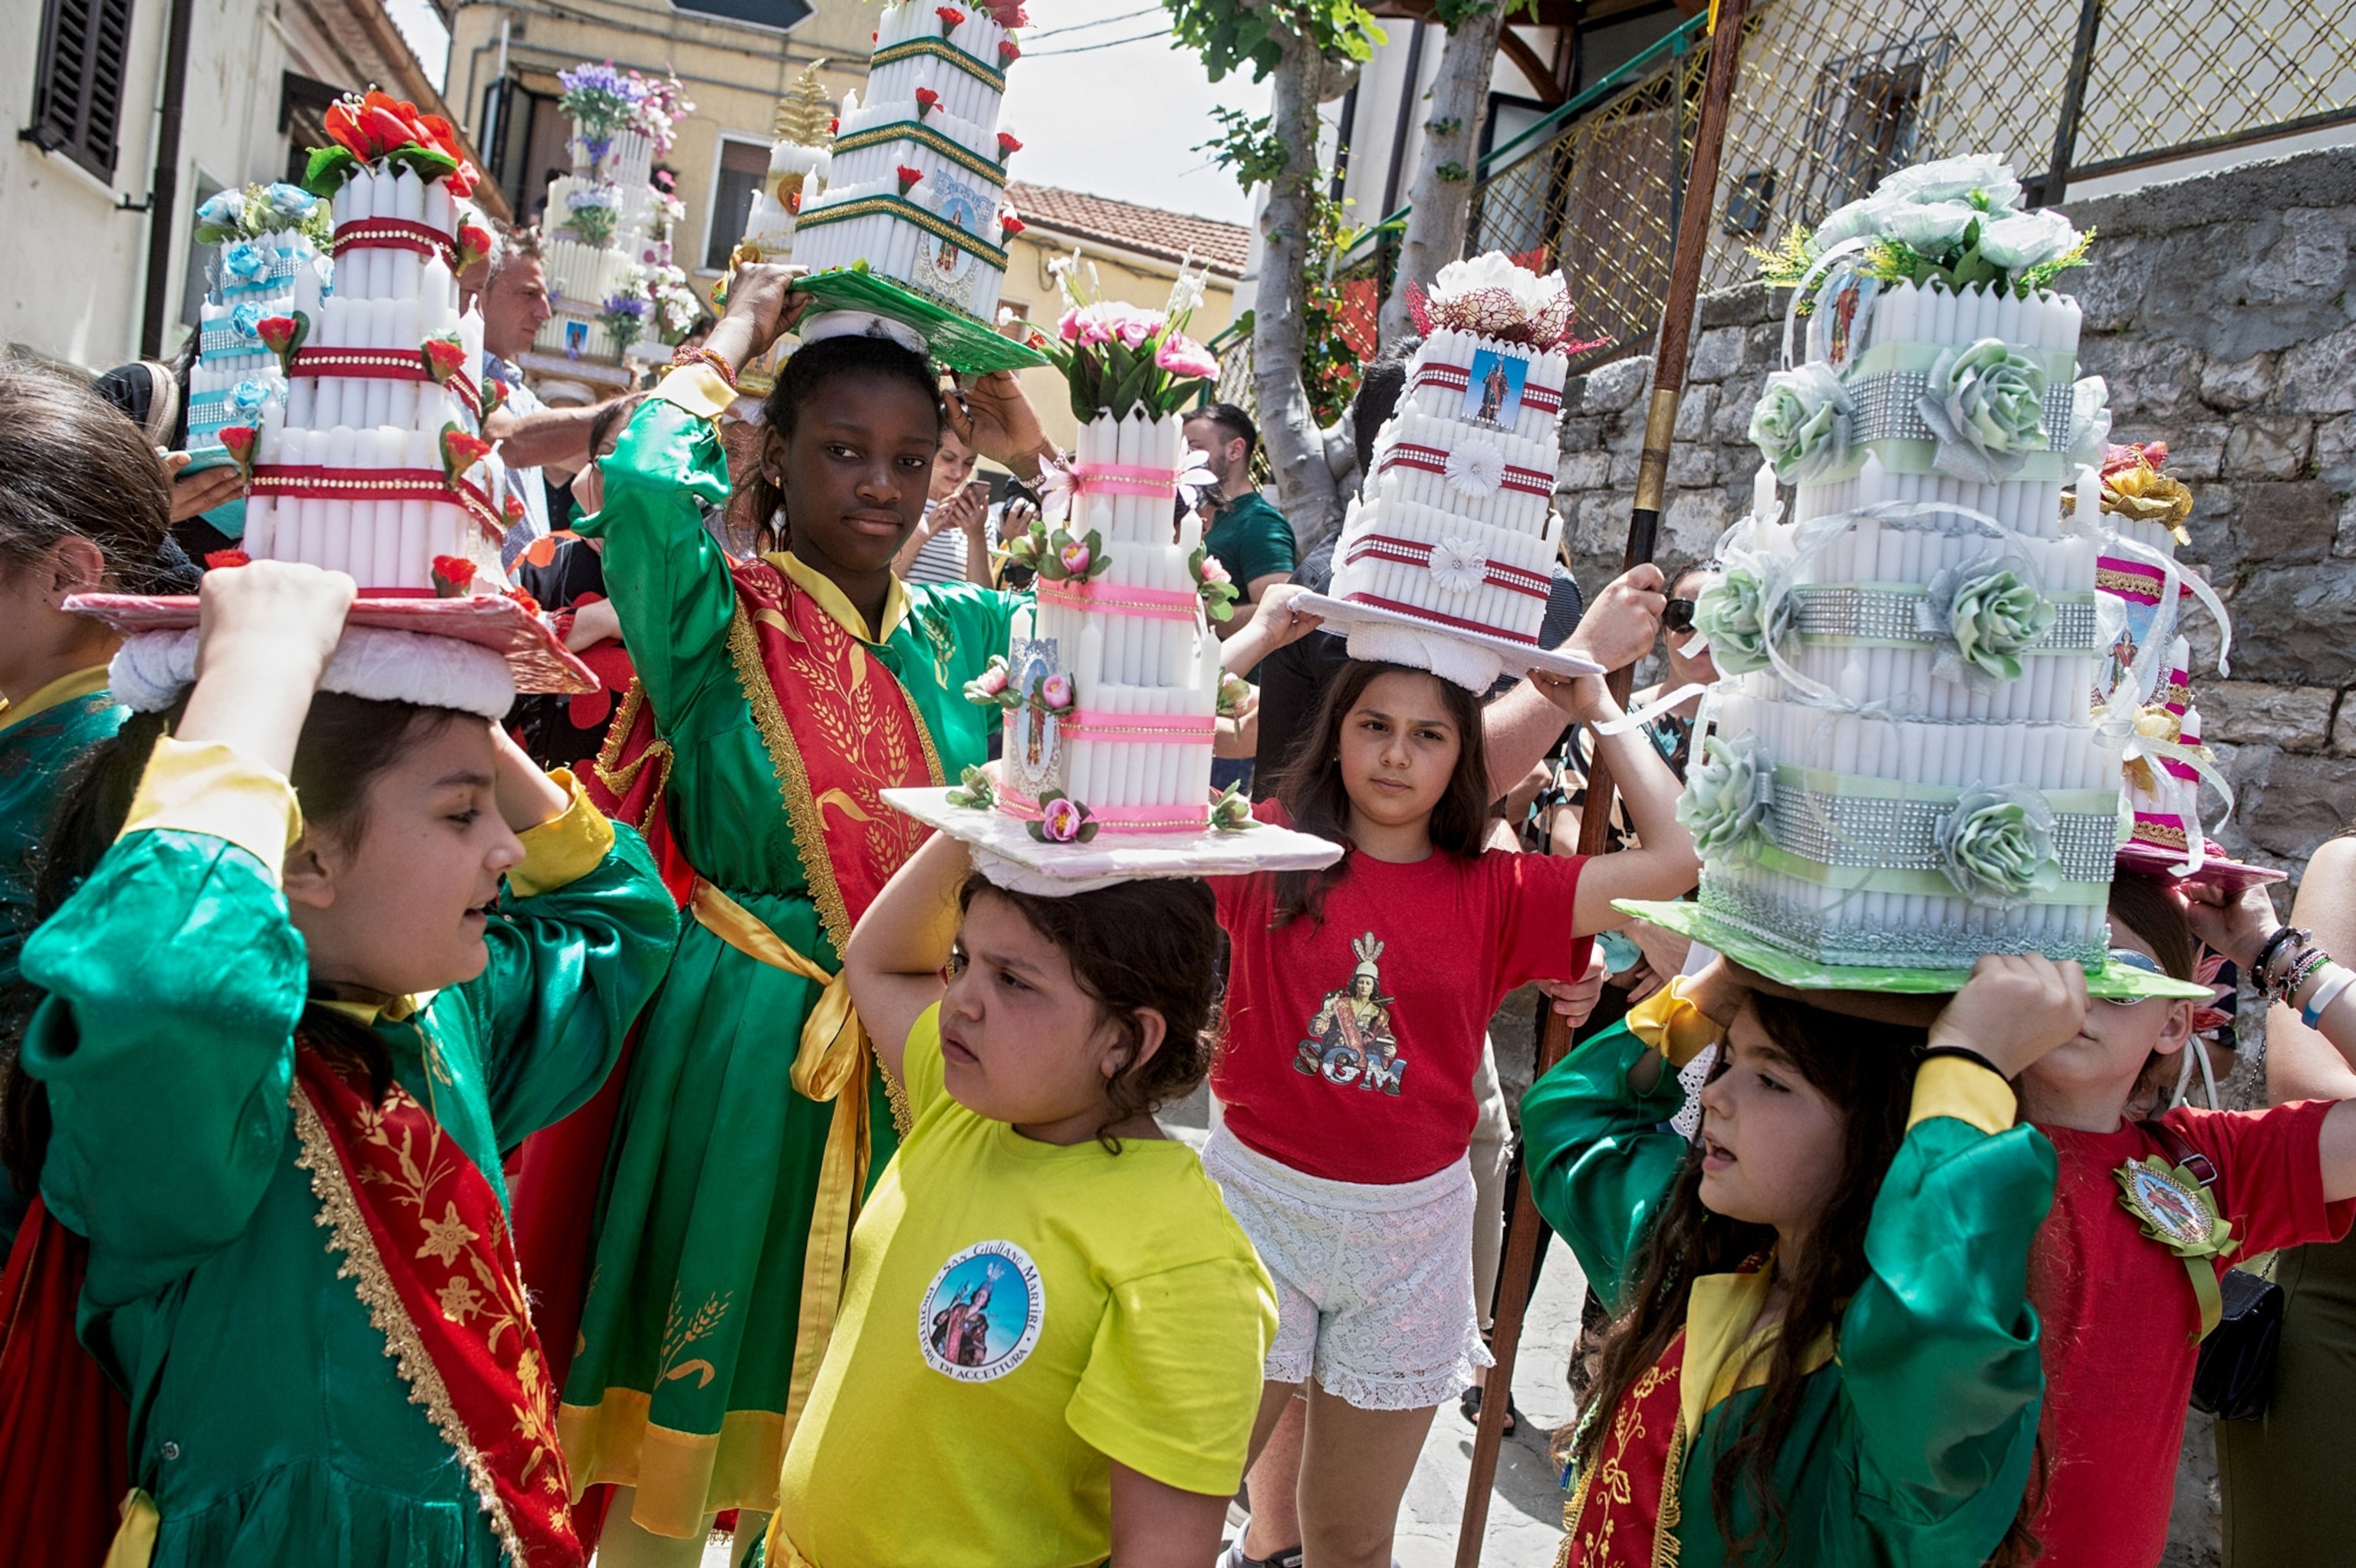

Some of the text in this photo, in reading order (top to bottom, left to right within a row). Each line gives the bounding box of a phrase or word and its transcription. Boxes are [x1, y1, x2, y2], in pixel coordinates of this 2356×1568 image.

[1293, 1038, 1407, 1096] SGM
[943, 1253, 967, 1271] SAN
[939, 1363, 953, 1375] DI
[956, 1349, 1028, 1379] ACCETTURA
